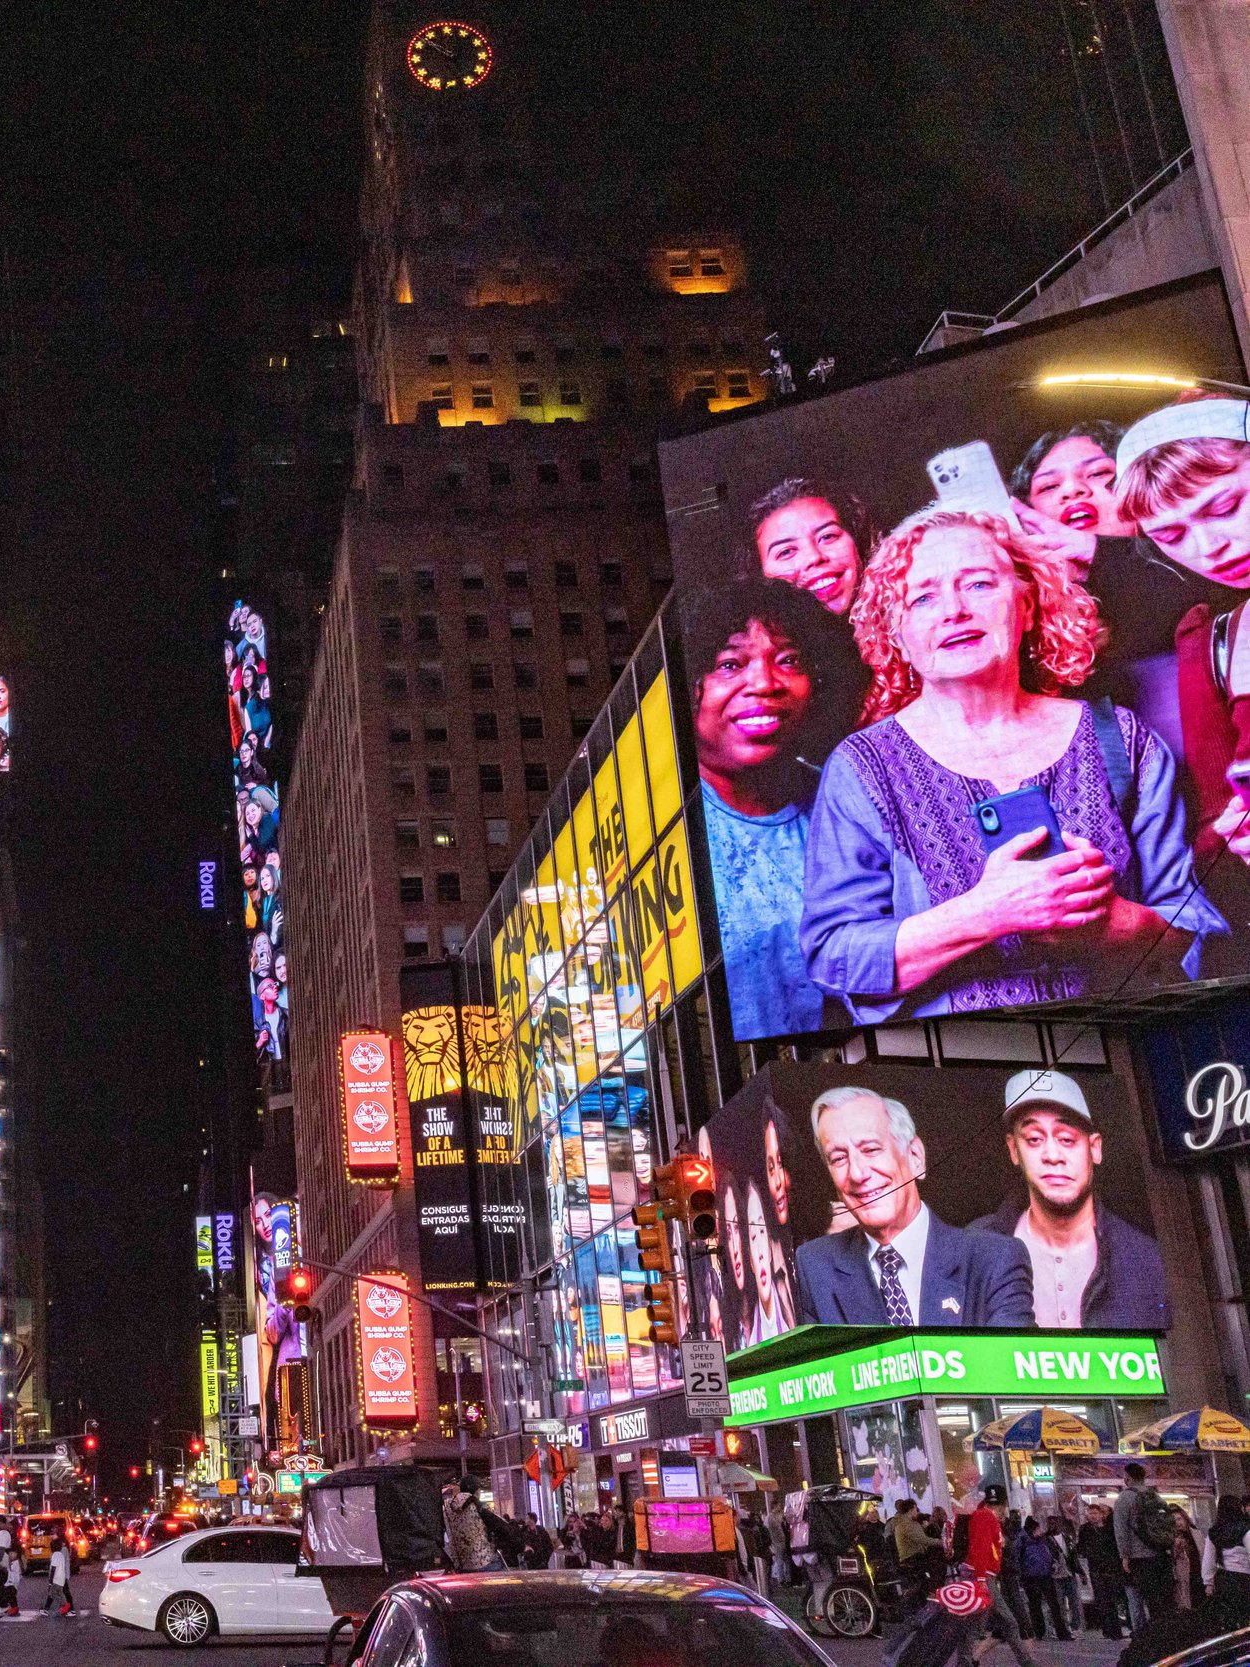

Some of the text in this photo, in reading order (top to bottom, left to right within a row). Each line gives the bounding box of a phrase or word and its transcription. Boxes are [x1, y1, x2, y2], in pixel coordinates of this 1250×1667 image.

[199, 862, 216, 908] ROKU
[616, 842, 685, 997] KING
[427, 1107, 447, 1121] THE
[422, 1121, 454, 1136] SHOW
[427, 1135, 452, 1150] OF A
[416, 1149, 465, 1166] LIFETIME
[421, 1205, 468, 1215] CONSIGUE
[421, 1215, 470, 1225] ENTRADAS
[435, 1224, 458, 1235] AQUÍ
[216, 1215, 234, 1270] ROKU
[275, 1251, 290, 1260] TACO
[276, 1259, 291, 1268] BELL
[425, 1282, 475, 1290] LIONKING.COM
[690, 1372, 723, 1392] 25
[731, 1386, 768, 1415] FRIENDS
[778, 1377, 806, 1406] NEW
[806, 1370, 837, 1399] YORK
[851, 1362, 881, 1391] LINE
[882, 1349, 966, 1386] FRIENDS
[1013, 1351, 1091, 1380] NEW
[615, 1411, 647, 1440] TISSOT
[1045, 1438, 1097, 1450] SABRETT
